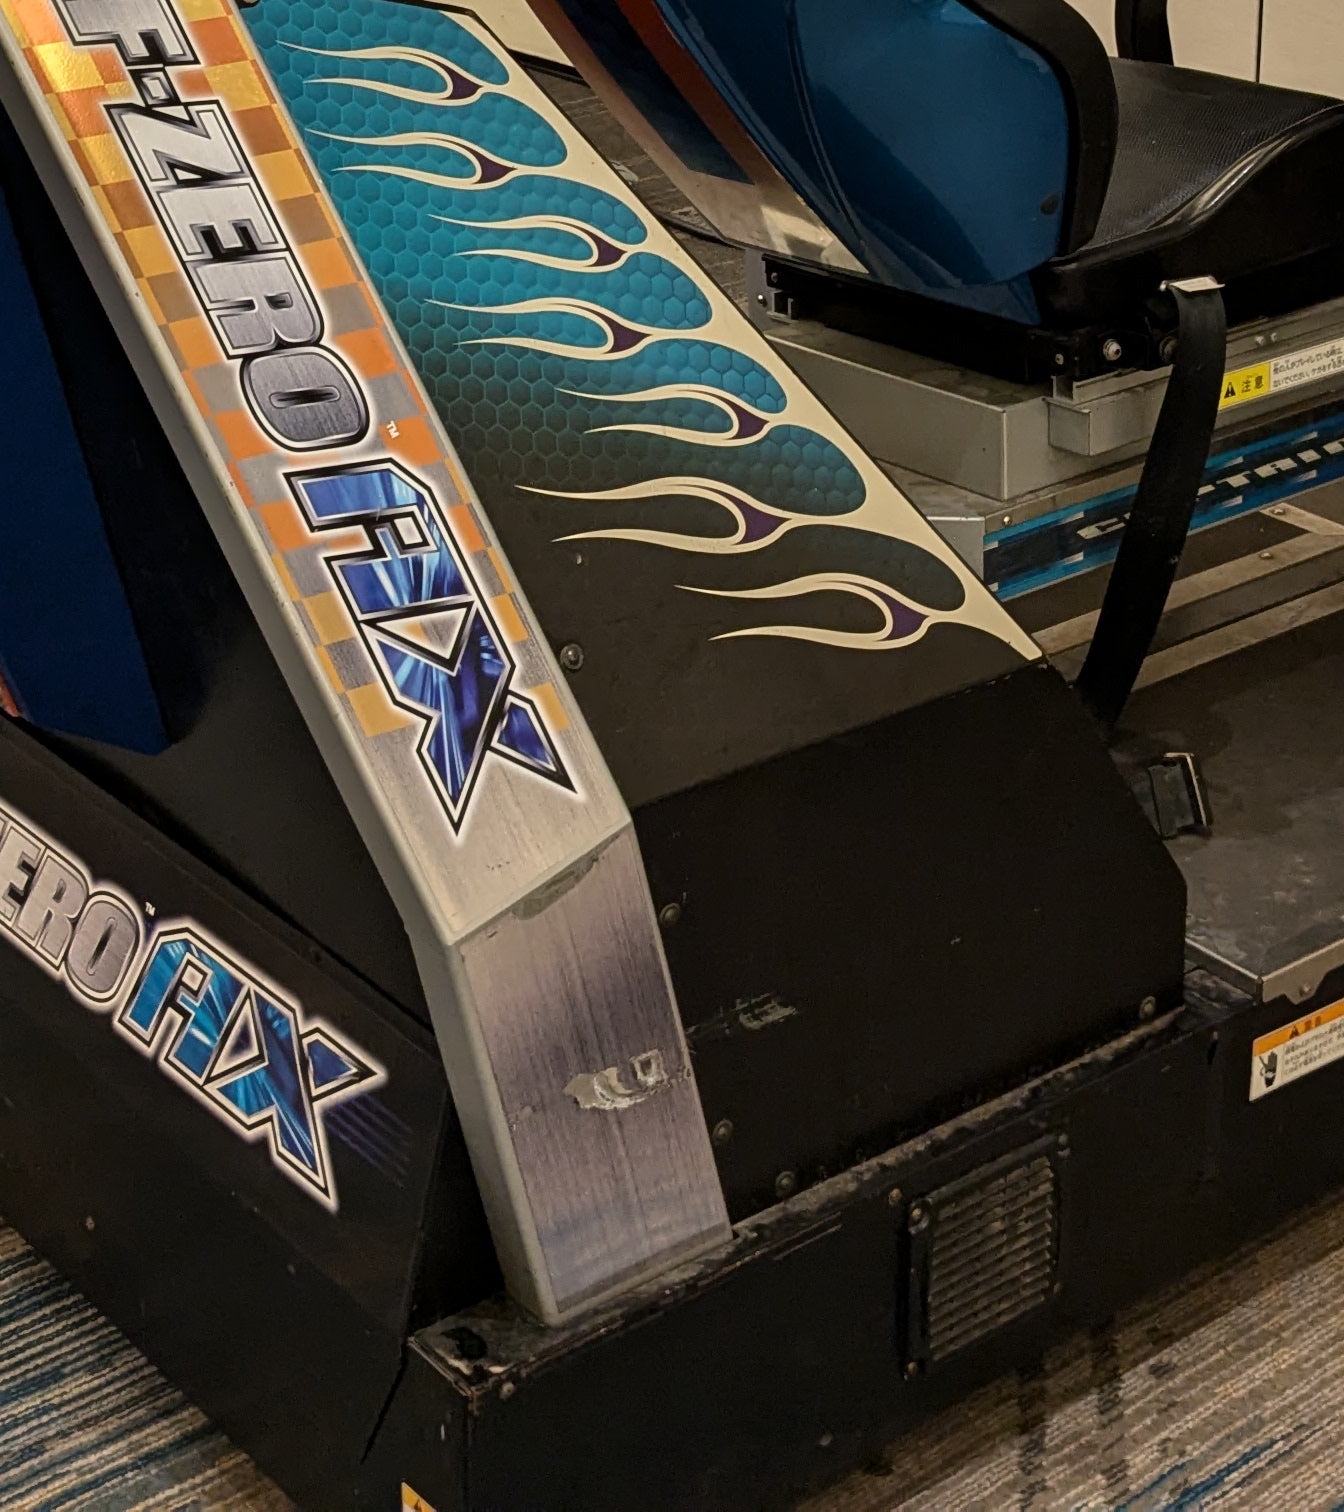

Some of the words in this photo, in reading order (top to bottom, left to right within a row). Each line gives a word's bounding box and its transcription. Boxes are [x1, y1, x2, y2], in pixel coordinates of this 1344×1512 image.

[1241, 375, 1264, 393] 注意
[280, 457, 579, 838] AX
[113, 920, 389, 1212] AX
